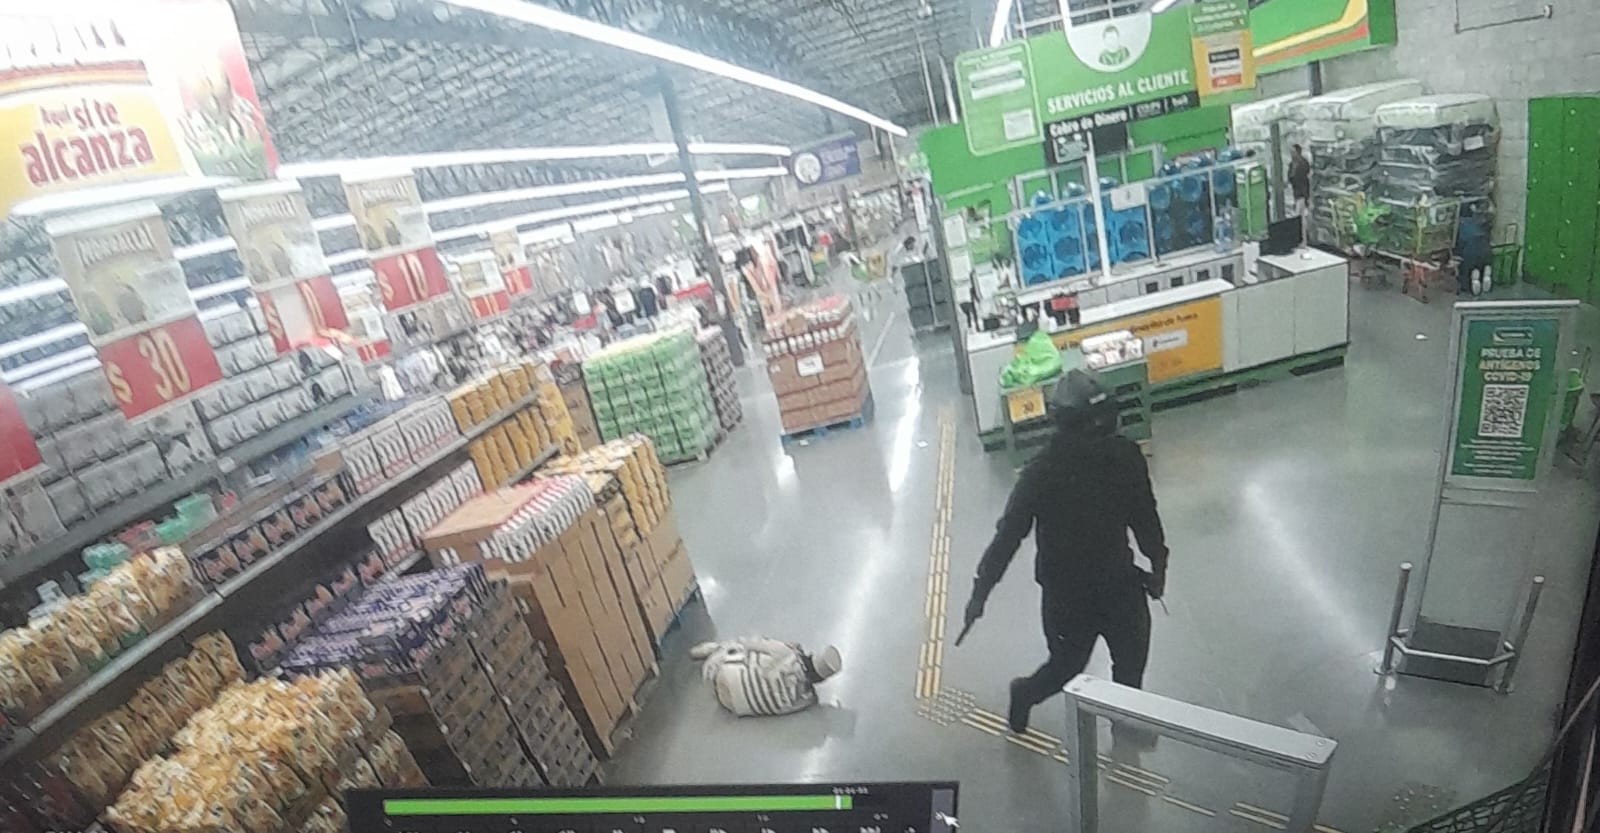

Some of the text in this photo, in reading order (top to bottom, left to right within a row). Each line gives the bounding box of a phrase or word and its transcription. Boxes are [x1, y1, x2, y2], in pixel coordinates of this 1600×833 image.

[1048, 85, 1115, 114] SERVICIOS
[1118, 80, 1135, 97] AL
[1137, 68, 1190, 92] CLIENTE
[21, 127, 155, 187] alcanza
[138, 327, 192, 401] 30
[1481, 347, 1541, 359] PRUEBA DE
